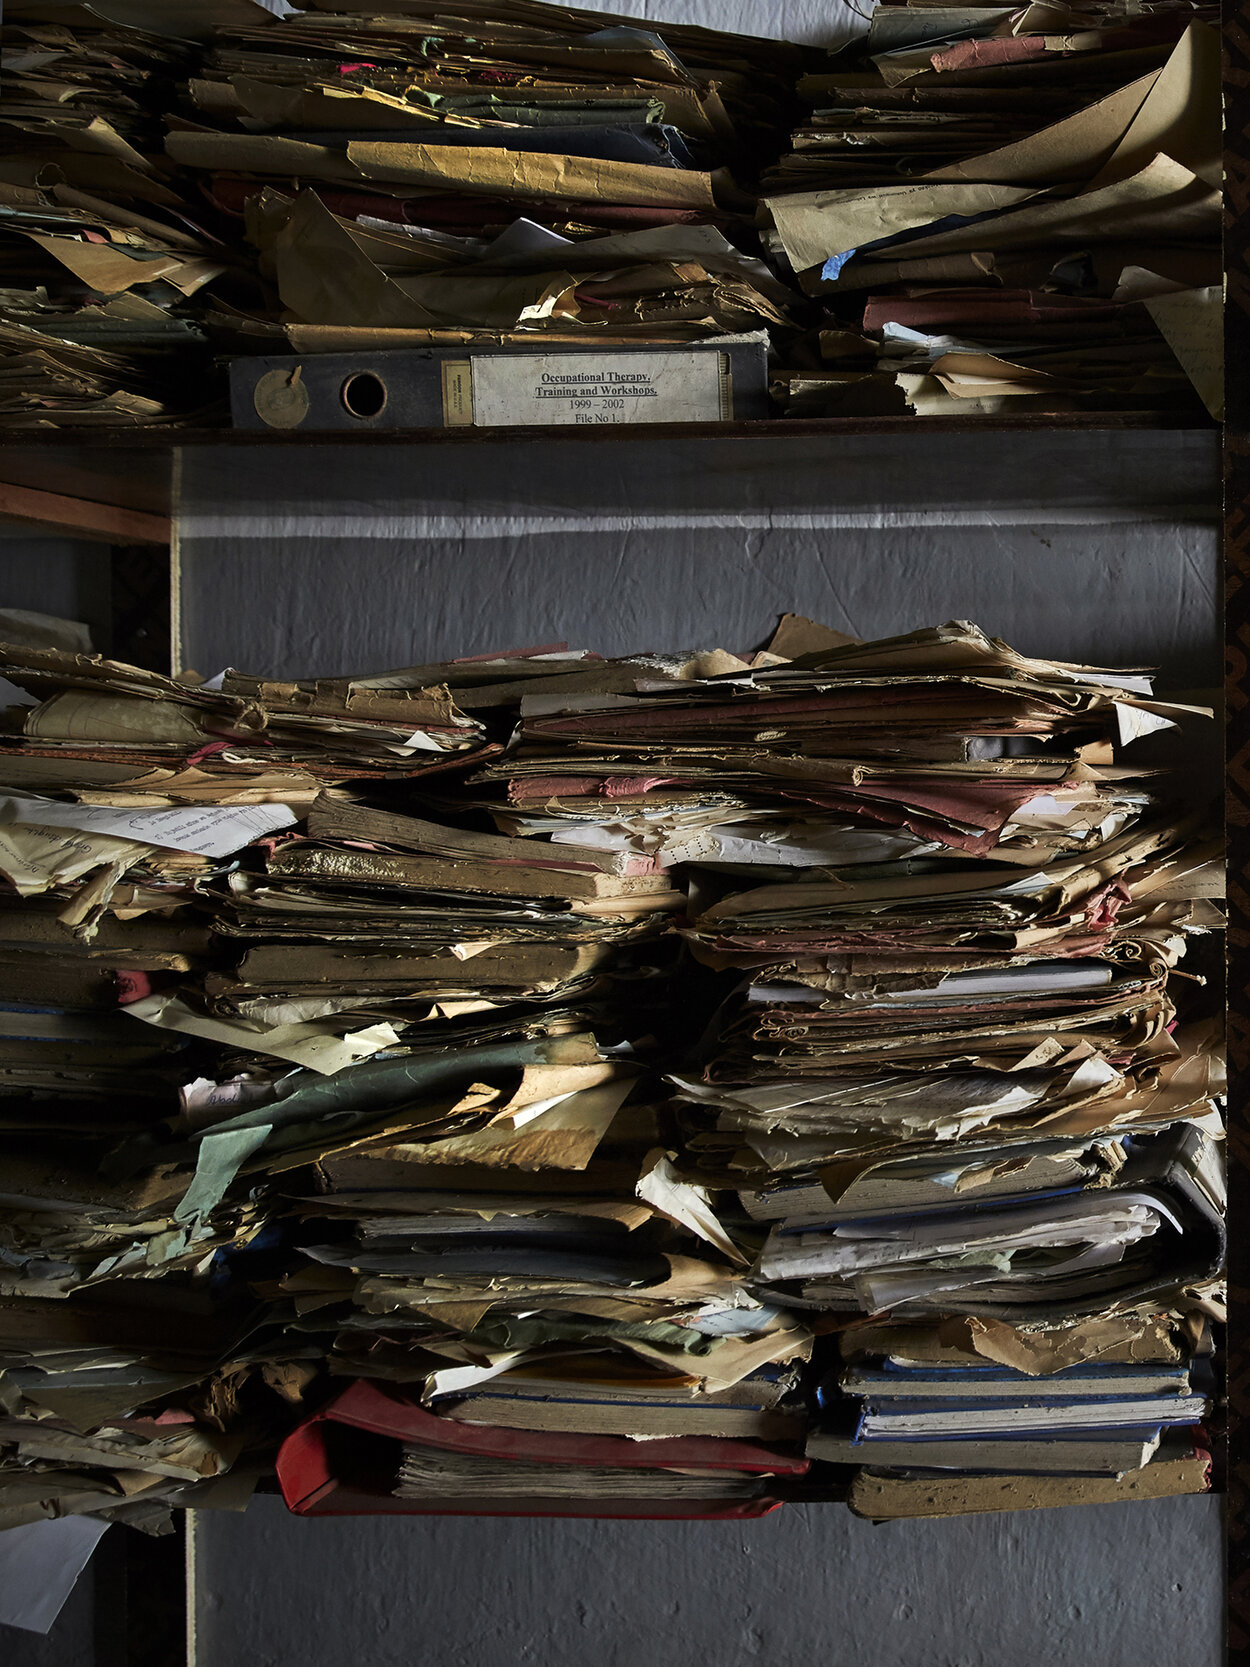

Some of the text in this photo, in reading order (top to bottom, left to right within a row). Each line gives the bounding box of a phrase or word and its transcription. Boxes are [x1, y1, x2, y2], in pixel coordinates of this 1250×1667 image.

[541, 372, 604, 384] Occupational
[535, 384, 657, 398] Training and Workshops.
[569, 400, 592, 410] 1999
[602, 398, 625, 409] 2002
[575, 412, 620, 423] File No 1.
